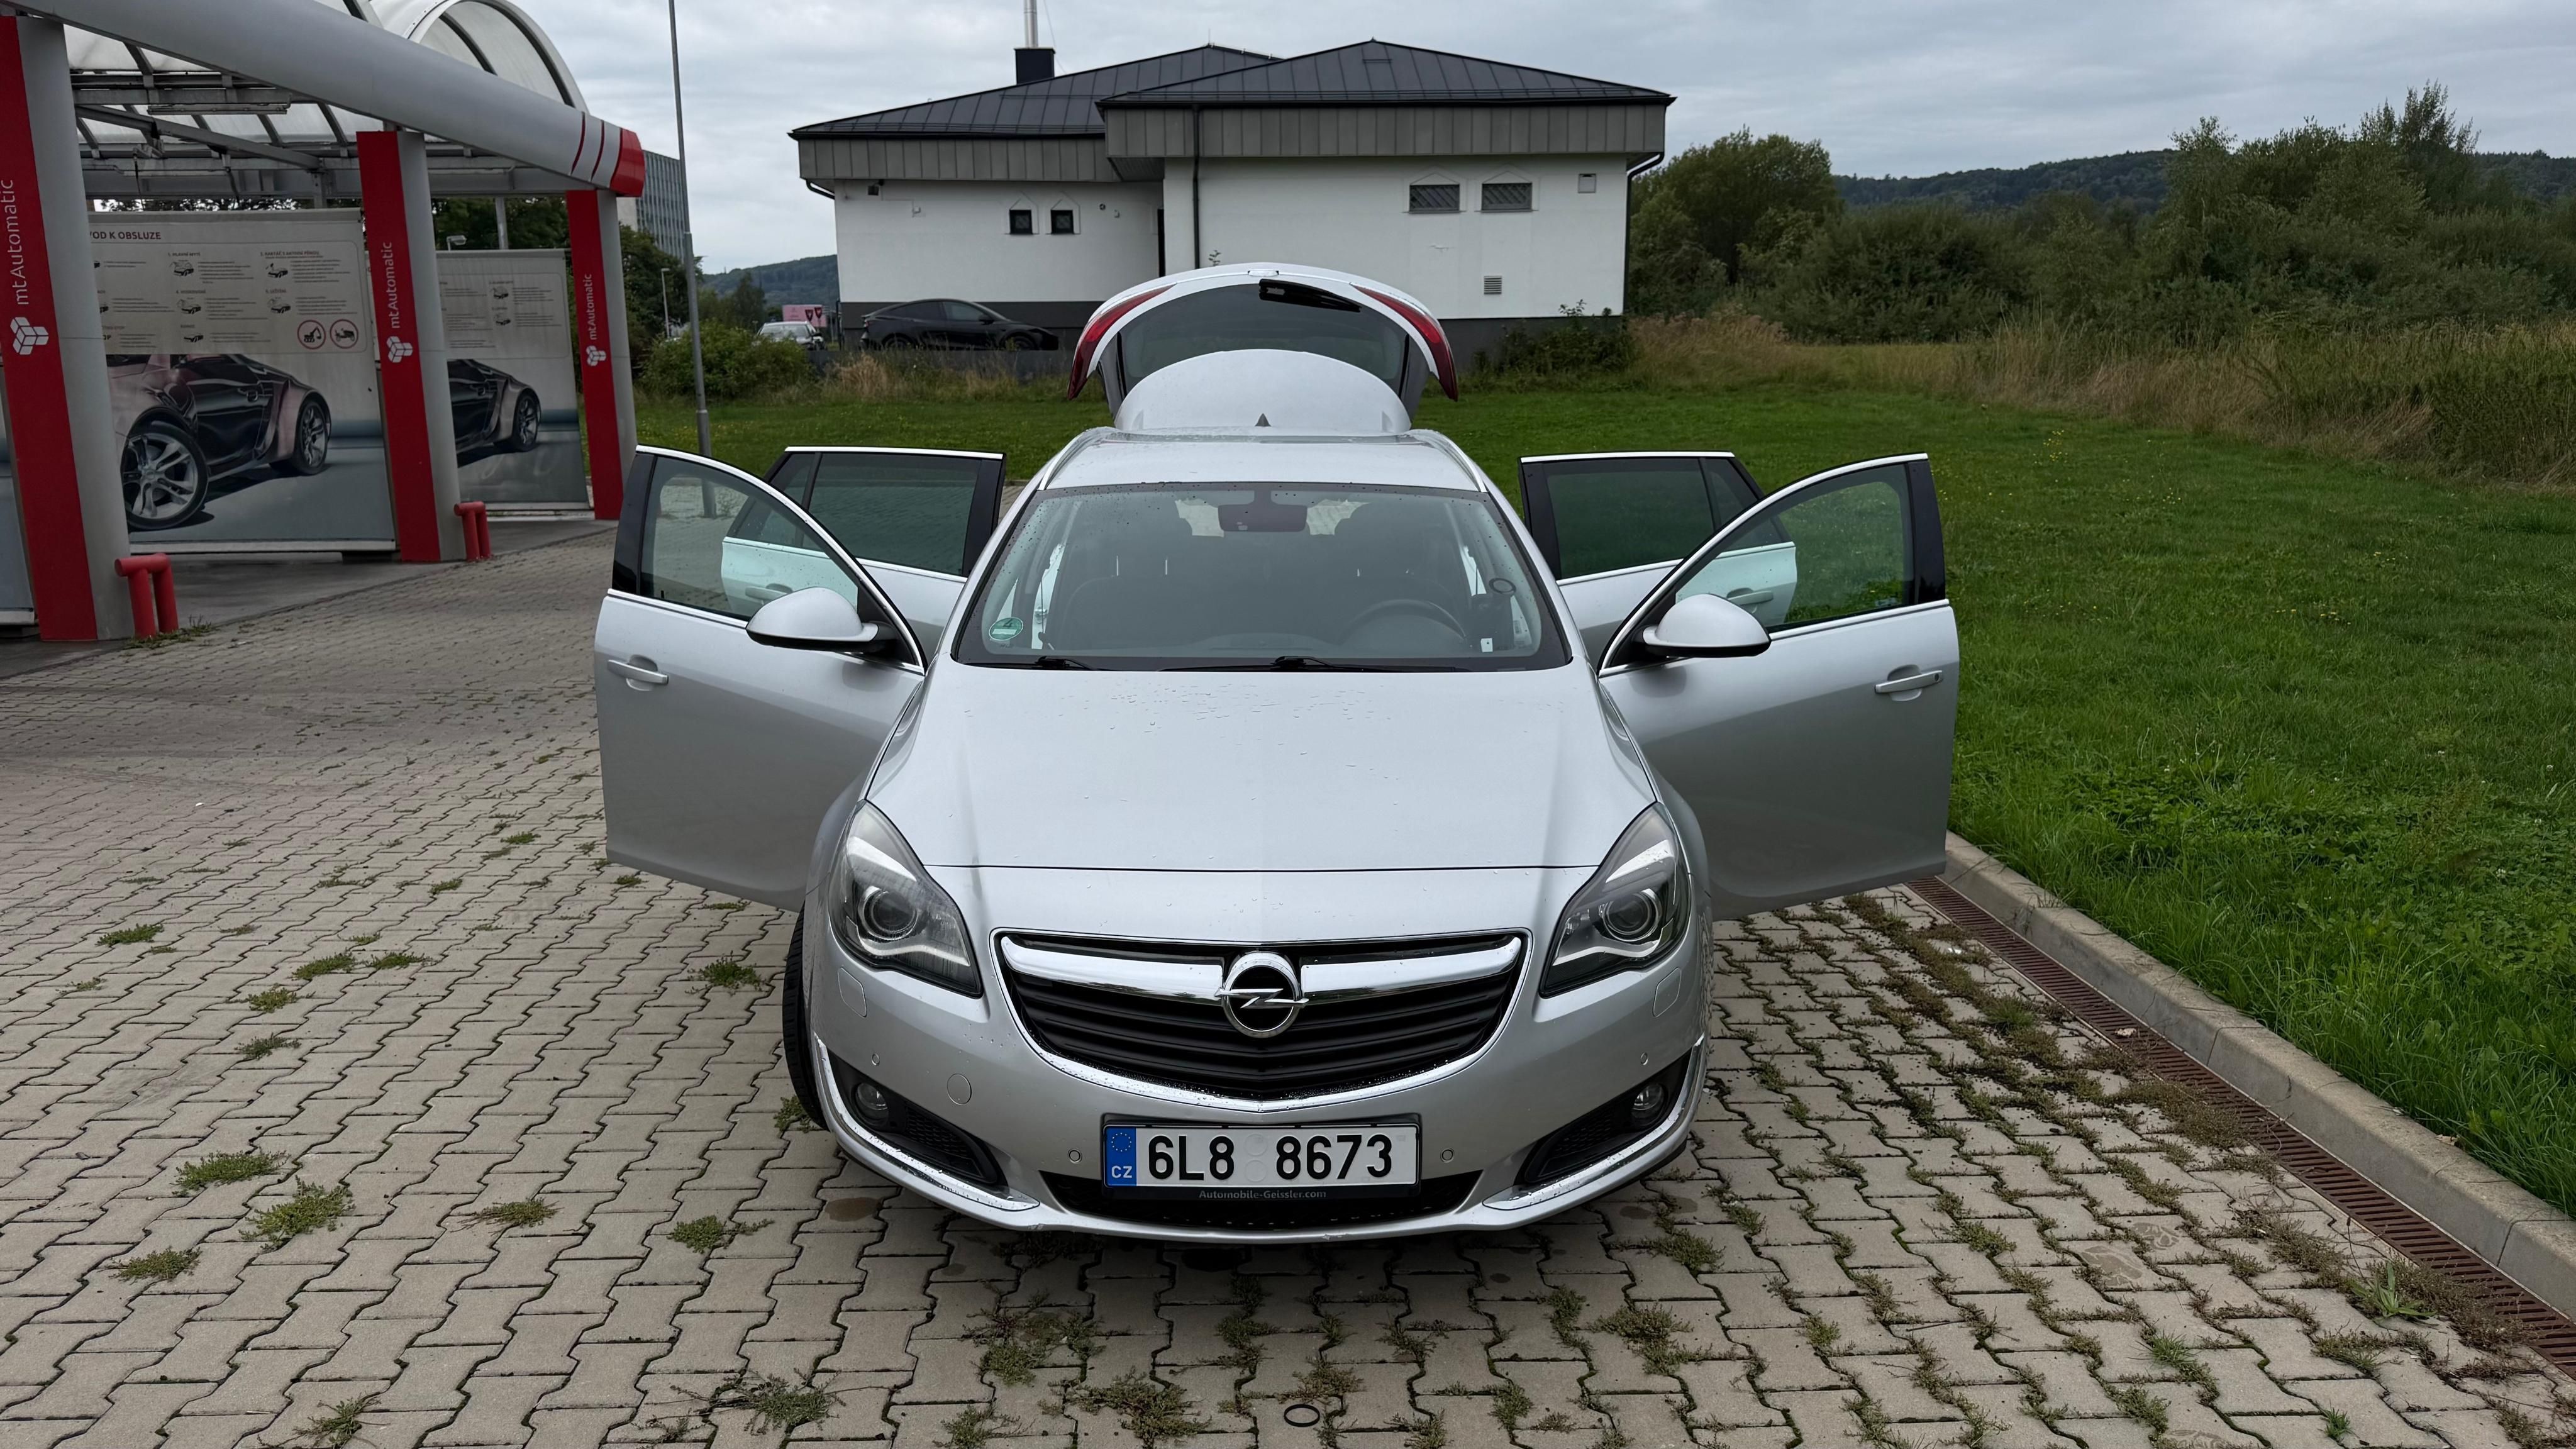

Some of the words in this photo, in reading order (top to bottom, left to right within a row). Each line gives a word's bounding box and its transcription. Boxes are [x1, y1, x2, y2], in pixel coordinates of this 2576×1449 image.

[0, 179, 30, 305] mtAutomatic
[90, 231, 107, 240] OD
[109, 231, 116, 240] K
[118, 231, 162, 240] OBSLUZE
[380, 242, 401, 329] mtAutomatic
[582, 273, 597, 340] mtAutomatic
[1111, 1165, 1133, 1179] CZ
[1148, 1135, 1235, 1181] 6L8
[1275, 1134, 1392, 1181] 8673
[1199, 1190, 1327, 1200] Automobile-Geissler.com
